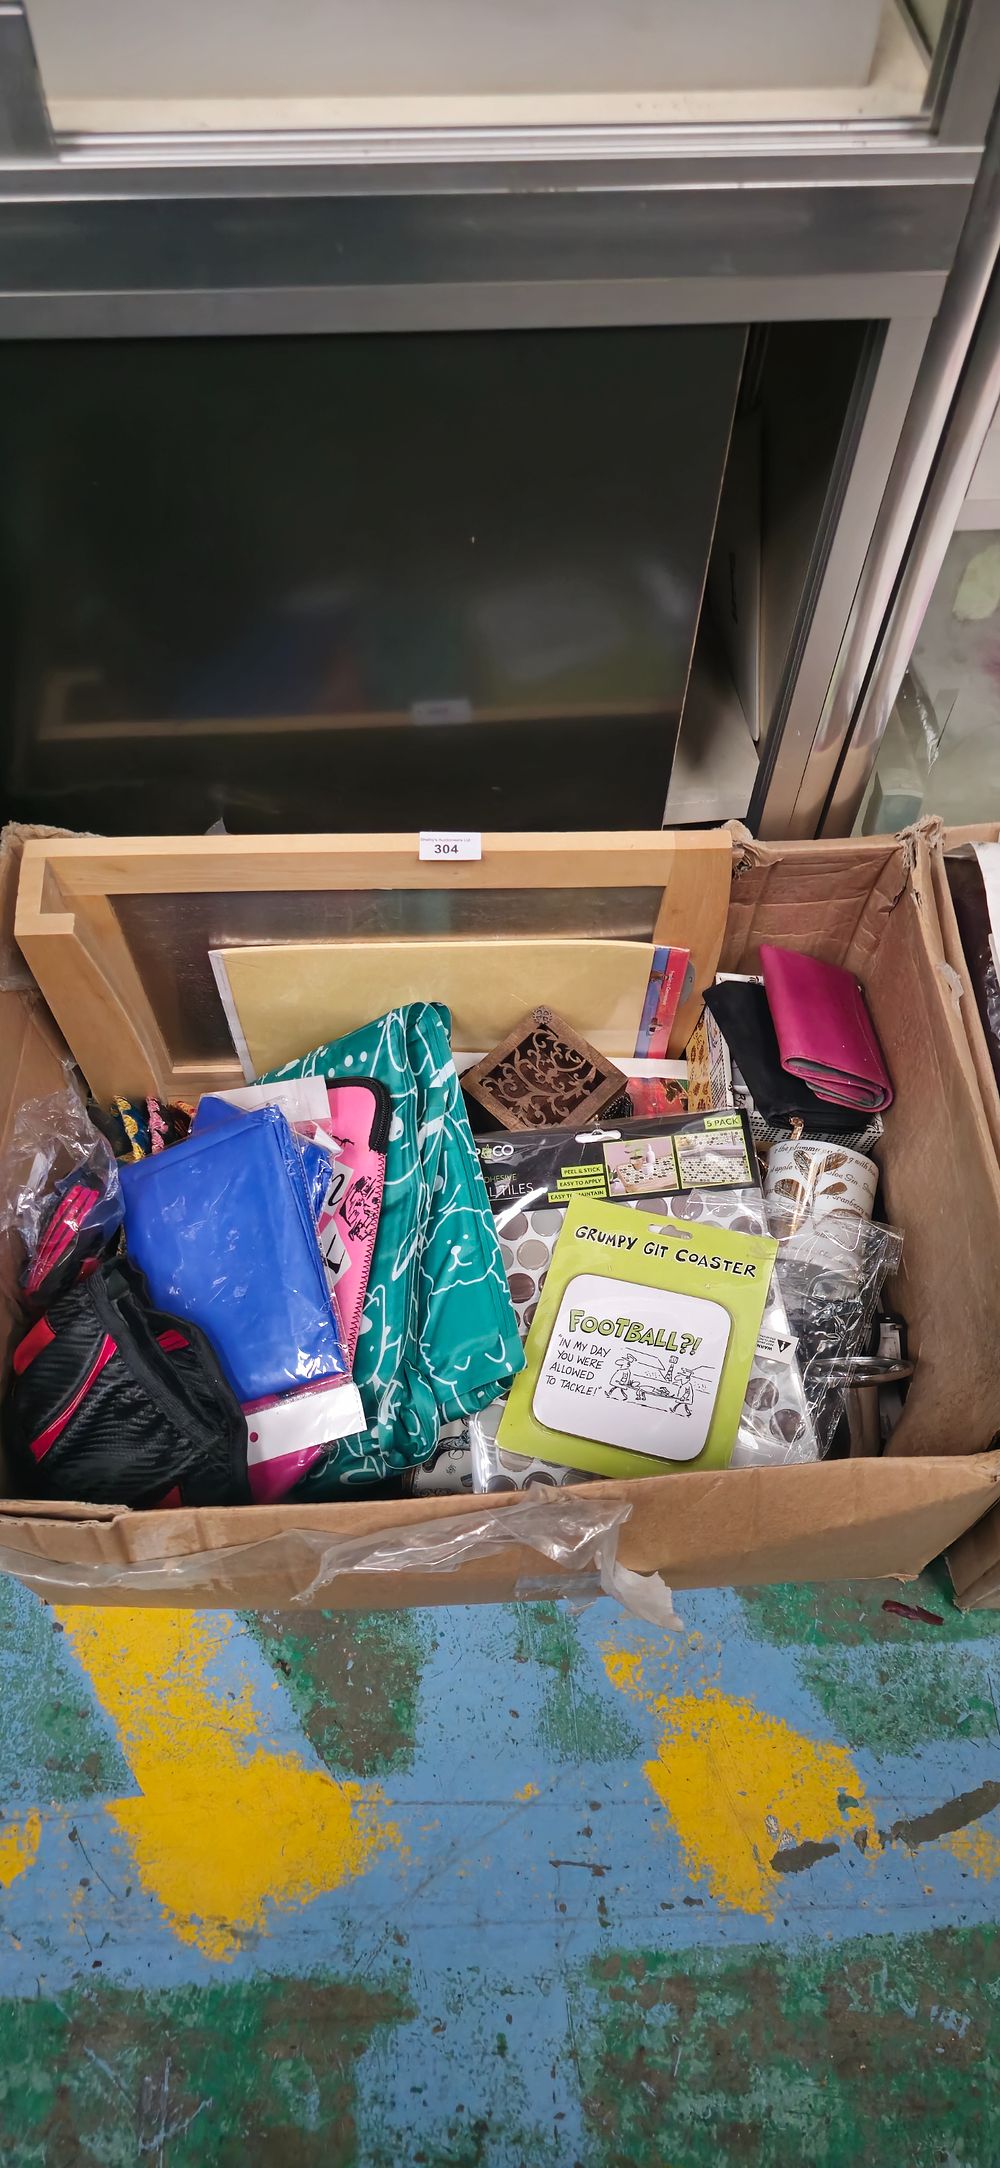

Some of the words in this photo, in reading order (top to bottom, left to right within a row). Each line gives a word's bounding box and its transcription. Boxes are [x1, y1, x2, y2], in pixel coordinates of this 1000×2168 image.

[434, 844, 459, 854] 304
[714, 1117, 739, 1126] PACK
[575, 1225, 638, 1250] GRUMPY
[643, 1241, 669, 1258] GIT
[675, 1249, 757, 1278] COASTER
[569, 1308, 703, 1355] FOOTBALL?!
[573, 1340, 588, 1352] MY
[590, 1345, 611, 1359] DAY
[557, 1350, 574, 1363] YOU
[577, 1355, 604, 1370] WERE
[546, 1374, 557, 1386] TO
[550, 1361, 595, 1380] ALLOWED
